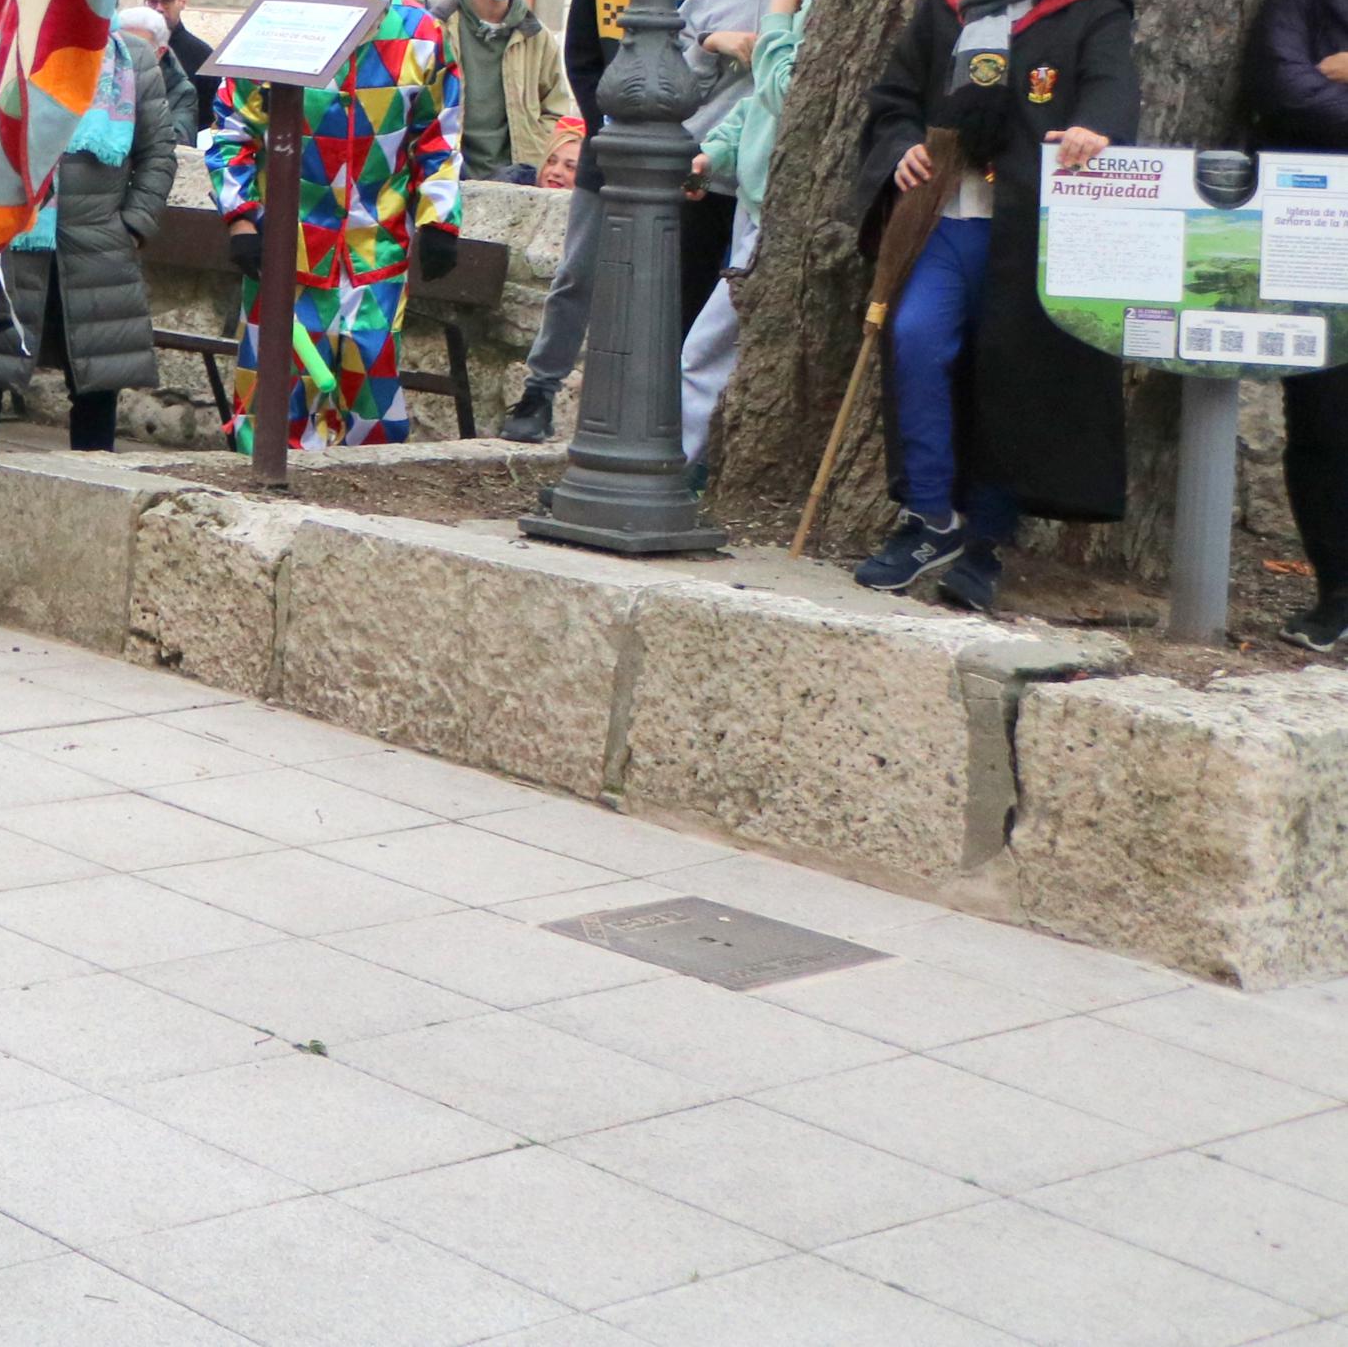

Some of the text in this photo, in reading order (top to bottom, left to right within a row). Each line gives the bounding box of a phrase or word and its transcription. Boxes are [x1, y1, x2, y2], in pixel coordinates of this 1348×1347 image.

[1086, 157, 1164, 173] CERRATO
[1102, 172, 1157, 181] PALENTINO
[1051, 180, 1160, 201] Antigüedad
[1125, 307, 1136, 319] 2
